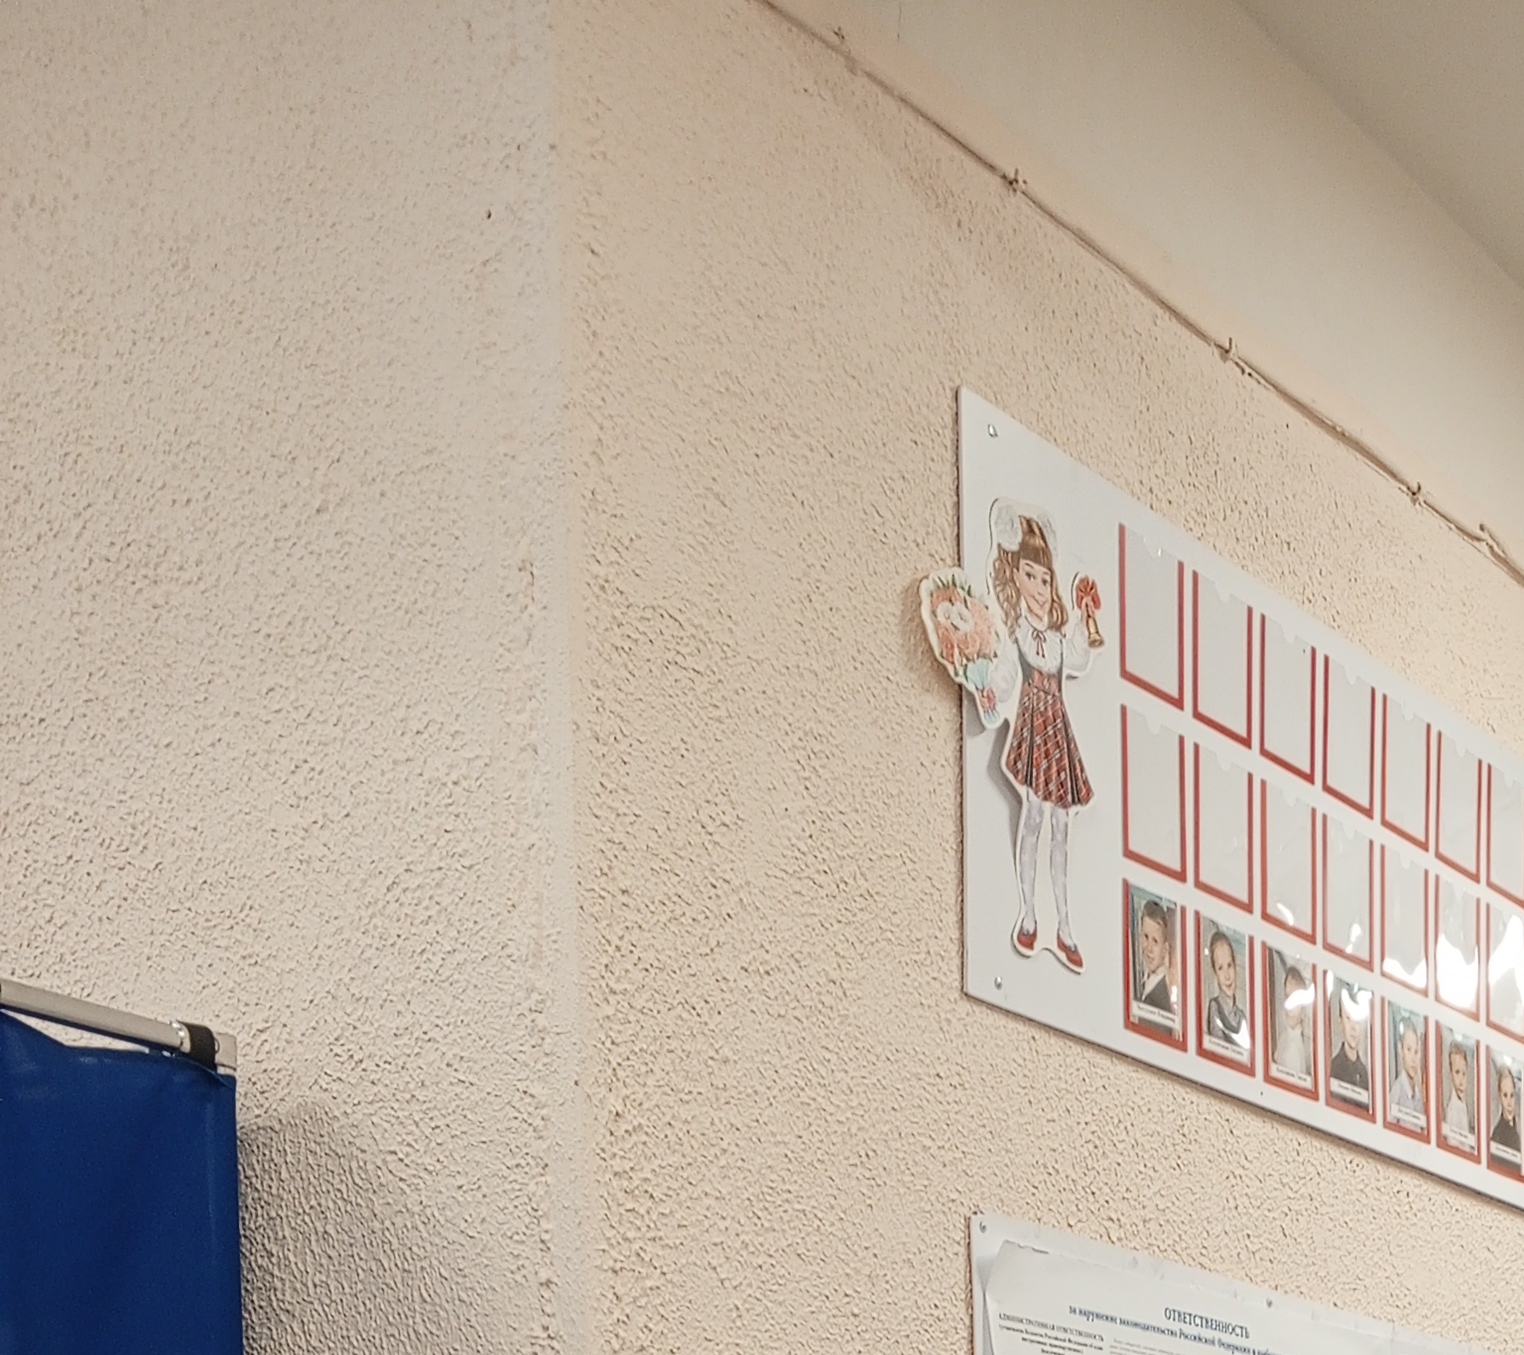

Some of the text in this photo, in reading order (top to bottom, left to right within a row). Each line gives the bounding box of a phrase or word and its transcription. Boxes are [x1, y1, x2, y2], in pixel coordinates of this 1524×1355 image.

[1078, 1307, 1118, 1325] нарушение
[1118, 1317, 1178, 1337] законодательства
[1178, 1327, 1216, 1347] Российской
[1217, 1337, 1251, 1355] Федерации
[1164, 1307, 1249, 1338] ОТВЕТСТВЕННОСТЬ
